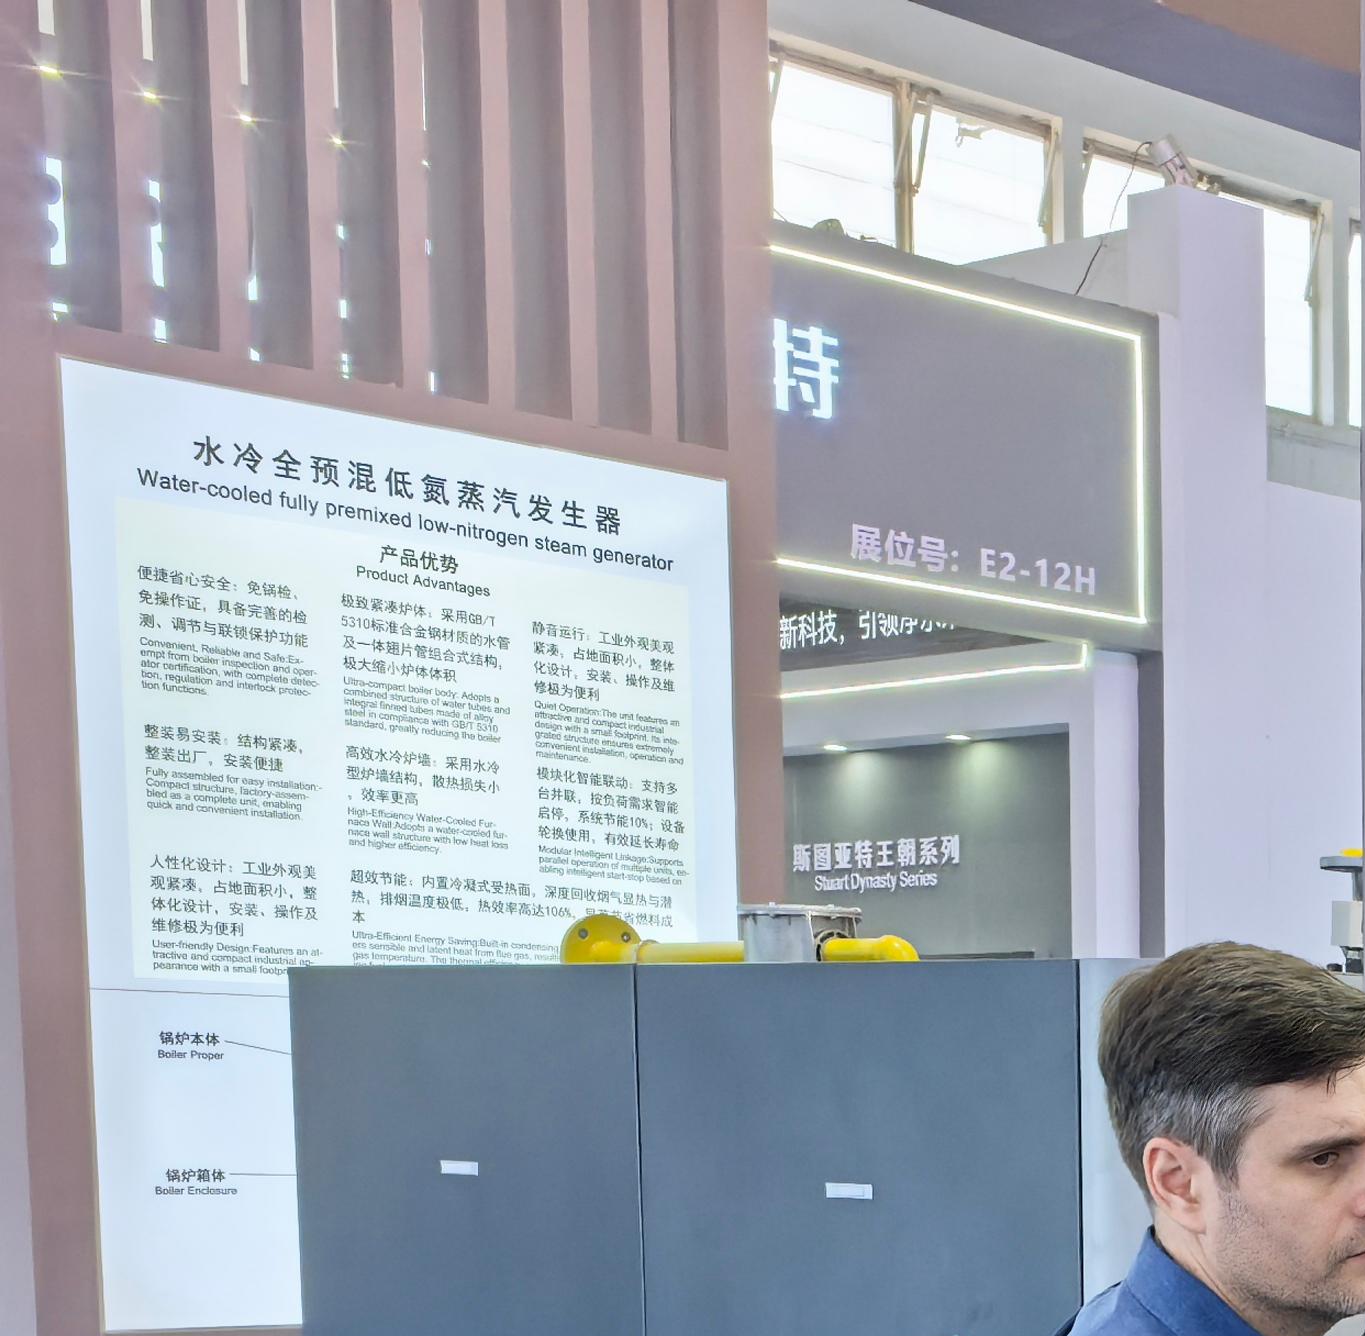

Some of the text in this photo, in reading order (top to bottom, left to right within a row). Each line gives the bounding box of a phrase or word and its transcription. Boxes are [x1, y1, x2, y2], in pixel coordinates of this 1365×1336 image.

[192, 435, 621, 536] 水冷全预混低氮蒸汽发生器
[136, 467, 675, 572] Water-cooled fully premixed low-nitrogen steam generator
[379, 544, 459, 575] 产品优势
[356, 564, 491, 598] Product Advantages
[814, 869, 938, 894] Stuart Dynasty Series
[159, 1031, 220, 1047] 锅炉本体
[157, 1050, 224, 1061] Boiler Proper
[165, 1168, 226, 1183] 锅炉箱体
[155, 1186, 237, 1196] Boiler Enclosure
